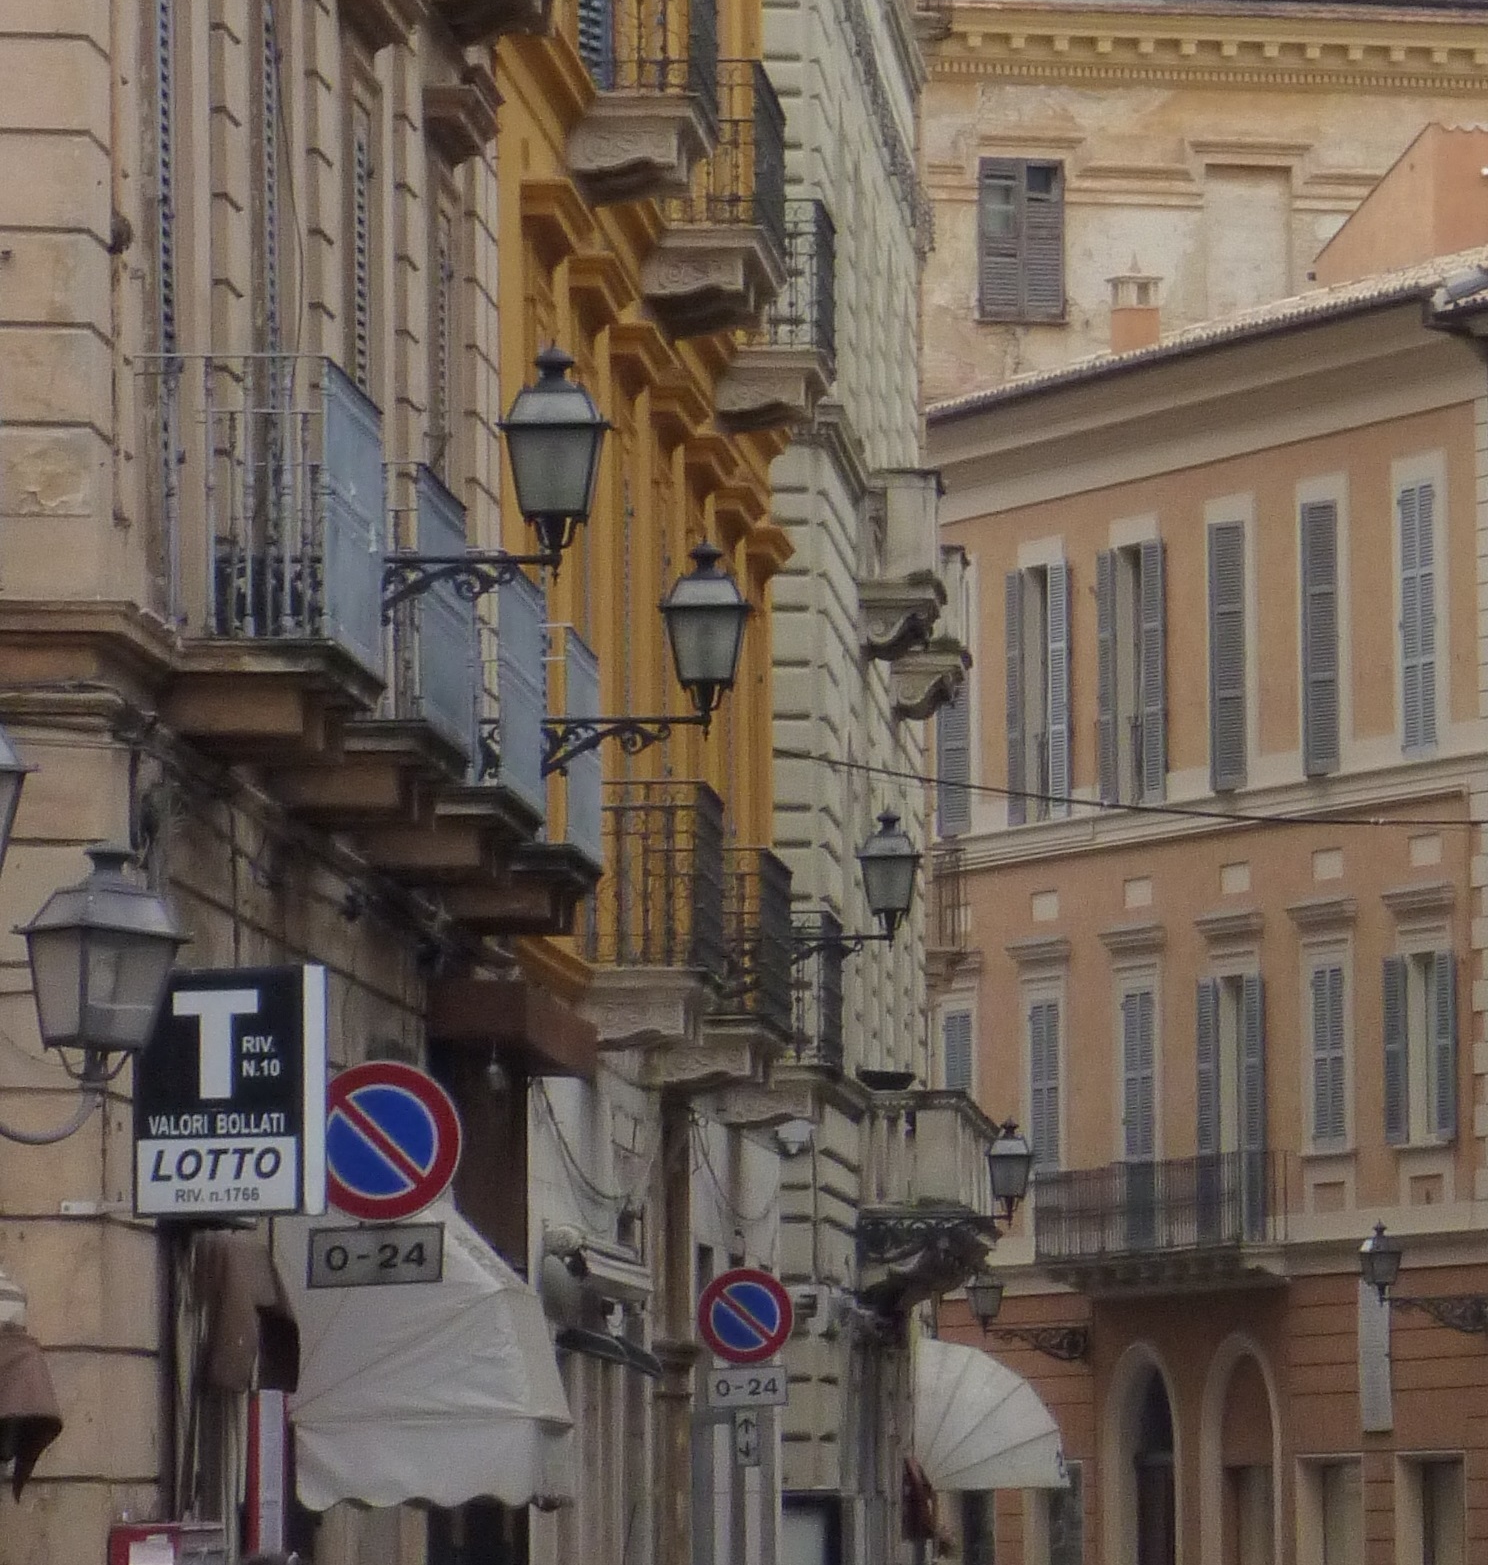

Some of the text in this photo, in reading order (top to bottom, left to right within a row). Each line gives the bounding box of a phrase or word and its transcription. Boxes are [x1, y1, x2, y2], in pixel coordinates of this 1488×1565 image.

[173, 989, 258, 1099] T
[242, 1036, 276, 1053] RIV.
[242, 1059, 281, 1077] N.10
[149, 1113, 285, 1135] VALORI BOLLATI
[151, 1147, 281, 1182] LOTTO
[175, 1188, 205, 1203] RIV.
